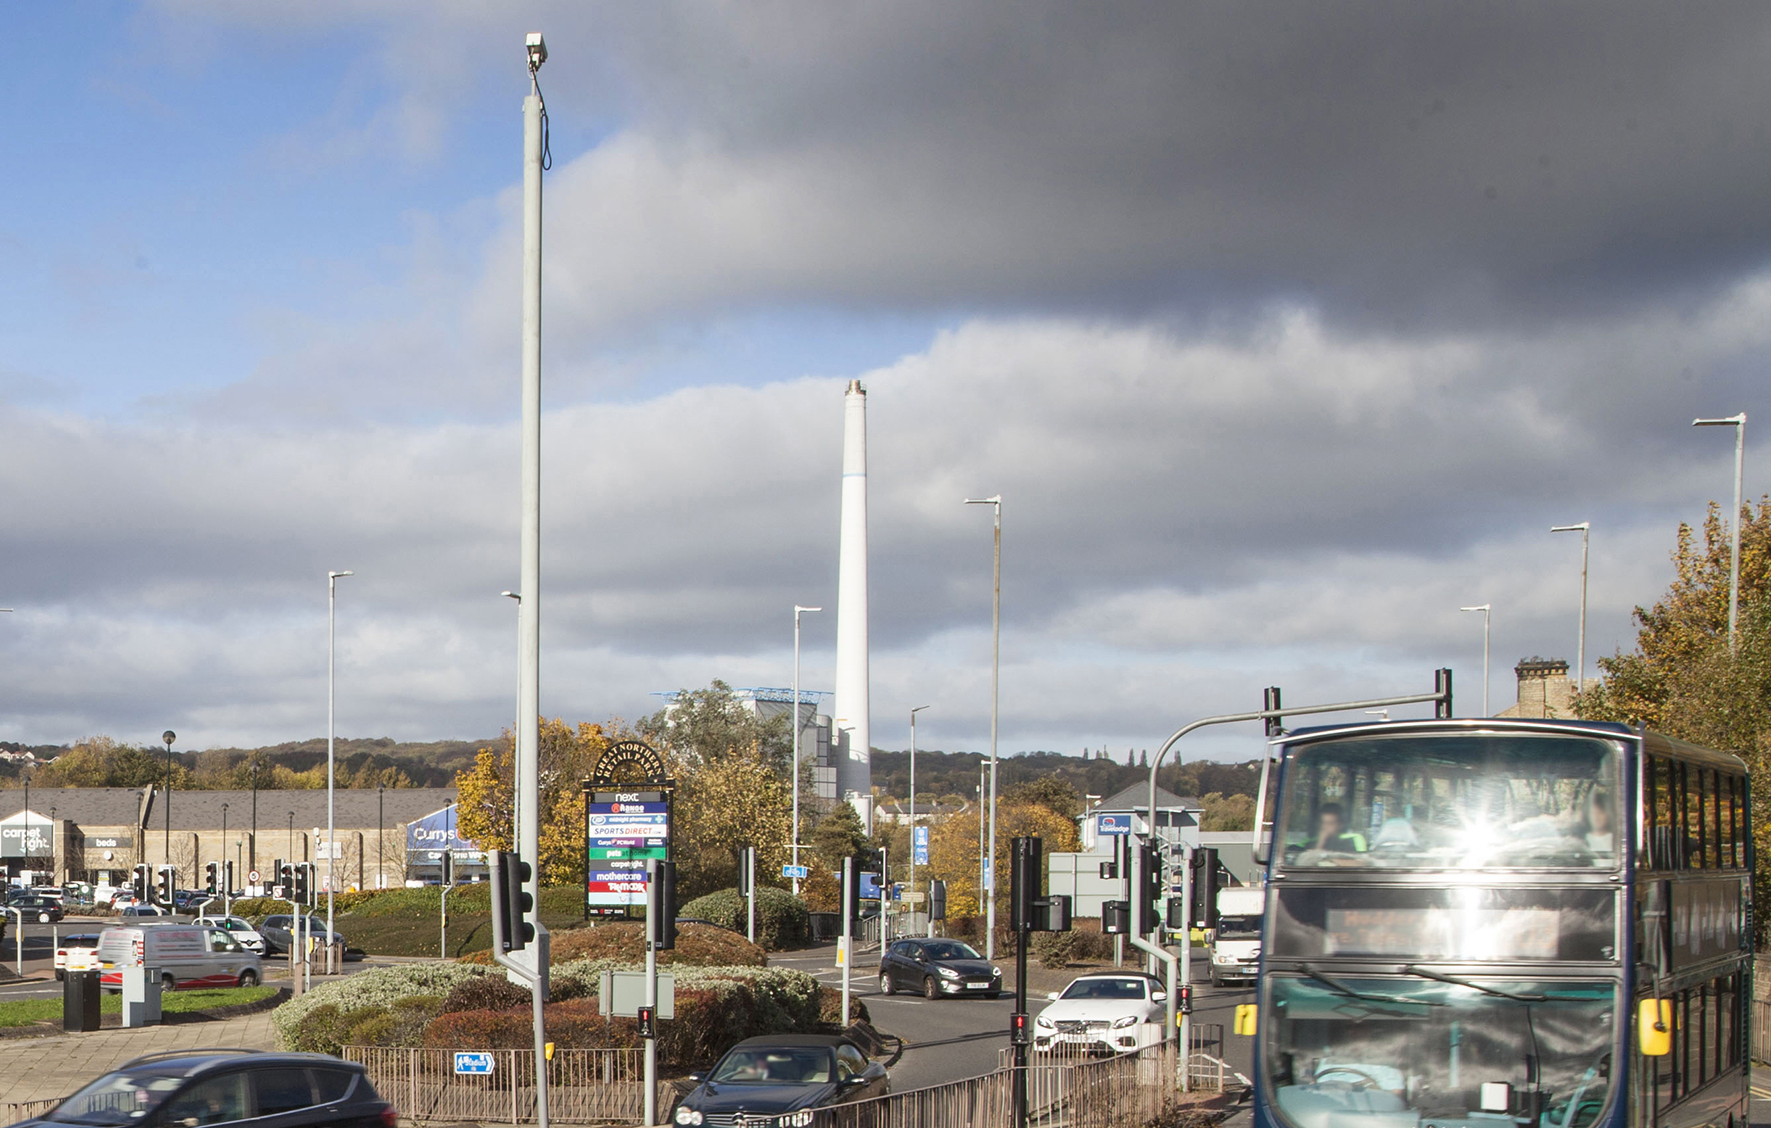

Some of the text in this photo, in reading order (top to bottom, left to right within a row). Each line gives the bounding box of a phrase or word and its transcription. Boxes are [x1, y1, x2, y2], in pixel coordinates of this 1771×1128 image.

[596, 743, 663, 777] GREAT NORTHERN
[603, 752, 655, 778] RETAIL PARK
[615, 793, 639, 802] next
[2, 827, 41, 840] carpet
[414, 827, 455, 842] Currys
[95, 838, 117, 847] beds
[606, 850, 622, 859] pets
[596, 872, 642, 881] mothercare
